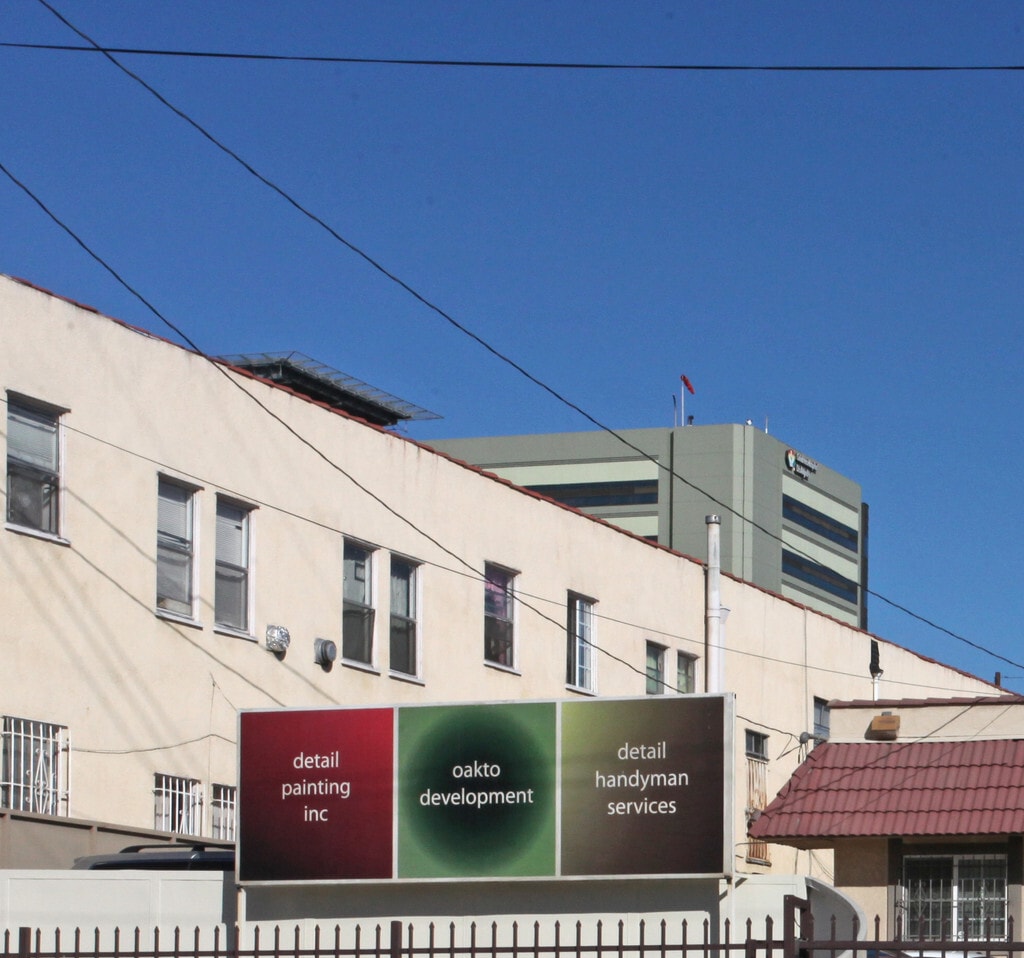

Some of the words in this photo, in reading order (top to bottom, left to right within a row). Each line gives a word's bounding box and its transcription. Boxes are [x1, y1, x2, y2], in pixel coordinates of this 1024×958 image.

[293, 750, 339, 769] detail
[617, 741, 667, 760] detail
[452, 760, 501, 779] oakto
[281, 778, 351, 800] painting
[595, 769, 689, 792] handyman
[419, 787, 534, 809] development
[607, 797, 677, 816] services
[303, 805, 329, 822] inc
